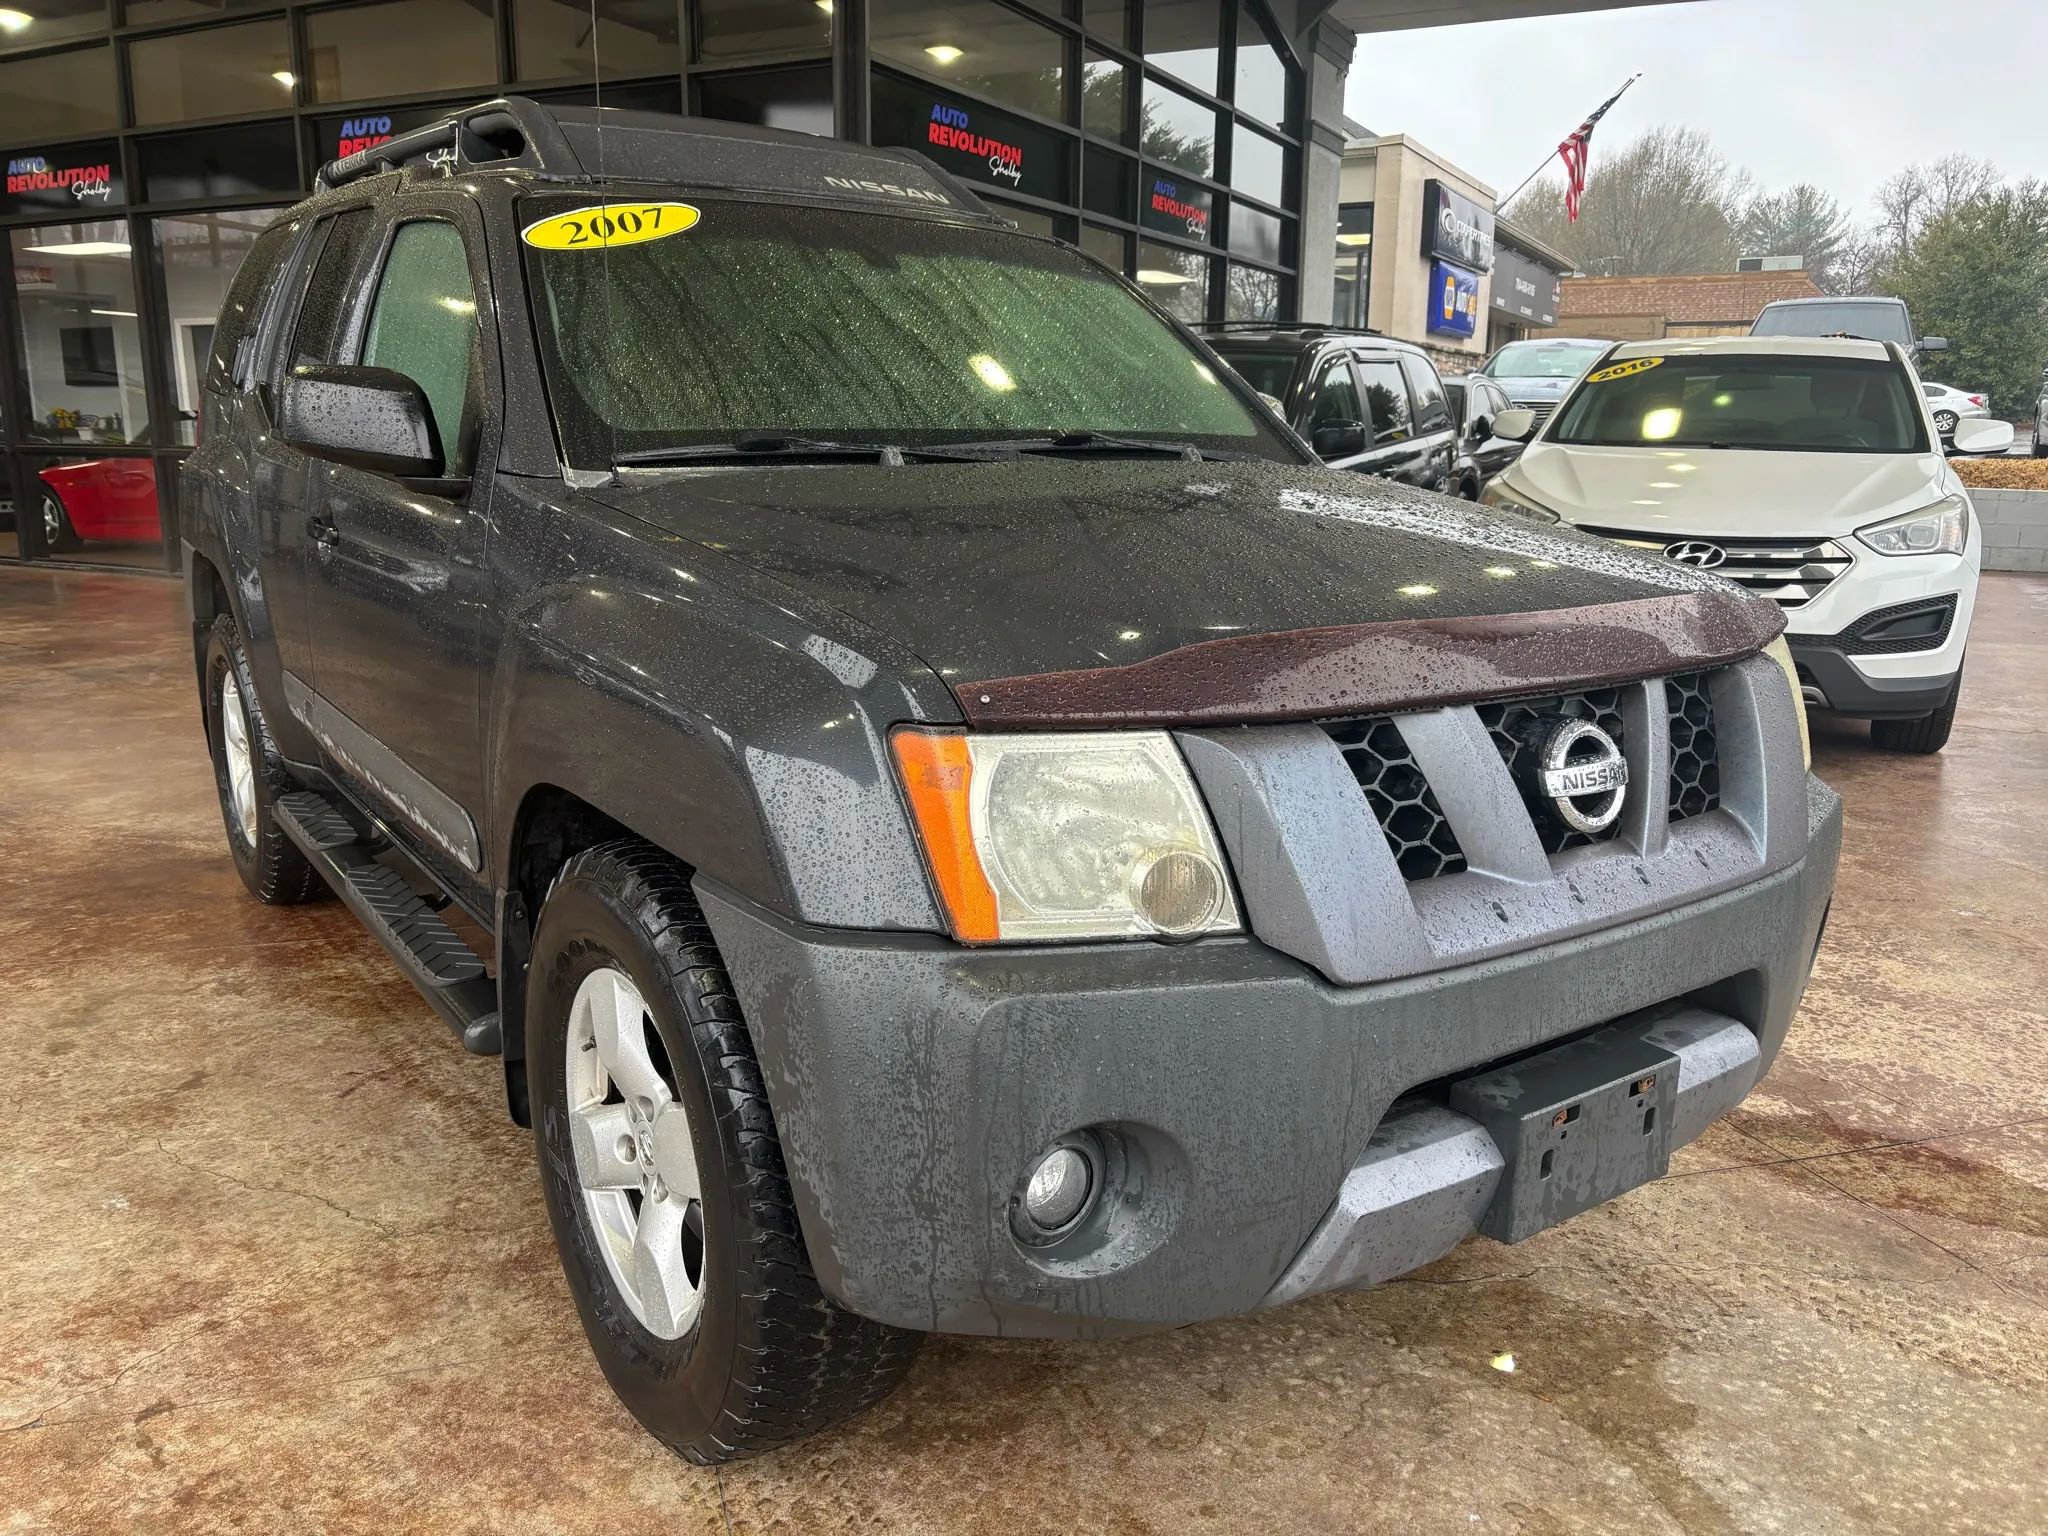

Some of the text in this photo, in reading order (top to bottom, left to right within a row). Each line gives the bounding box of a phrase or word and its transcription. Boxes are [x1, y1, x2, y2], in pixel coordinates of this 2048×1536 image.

[339, 116, 392, 137] AUTO
[931, 104, 968, 129] AUTO
[928, 122, 1022, 167] REVOLUTION
[7, 156, 45, 175] AUTO
[988, 155, 1022, 187] Shelby
[7, 164, 110, 193] REVOLUTION
[71, 177, 112, 201] Shelby
[823, 176, 950, 205] NISSAN
[1154, 181, 1176, 199] AUTO
[1152, 193, 1207, 225] REVOLUTION
[560, 207, 662, 245] 2007
[1597, 360, 1654, 380] 2016
[1561, 767, 1627, 791] NISSAN
